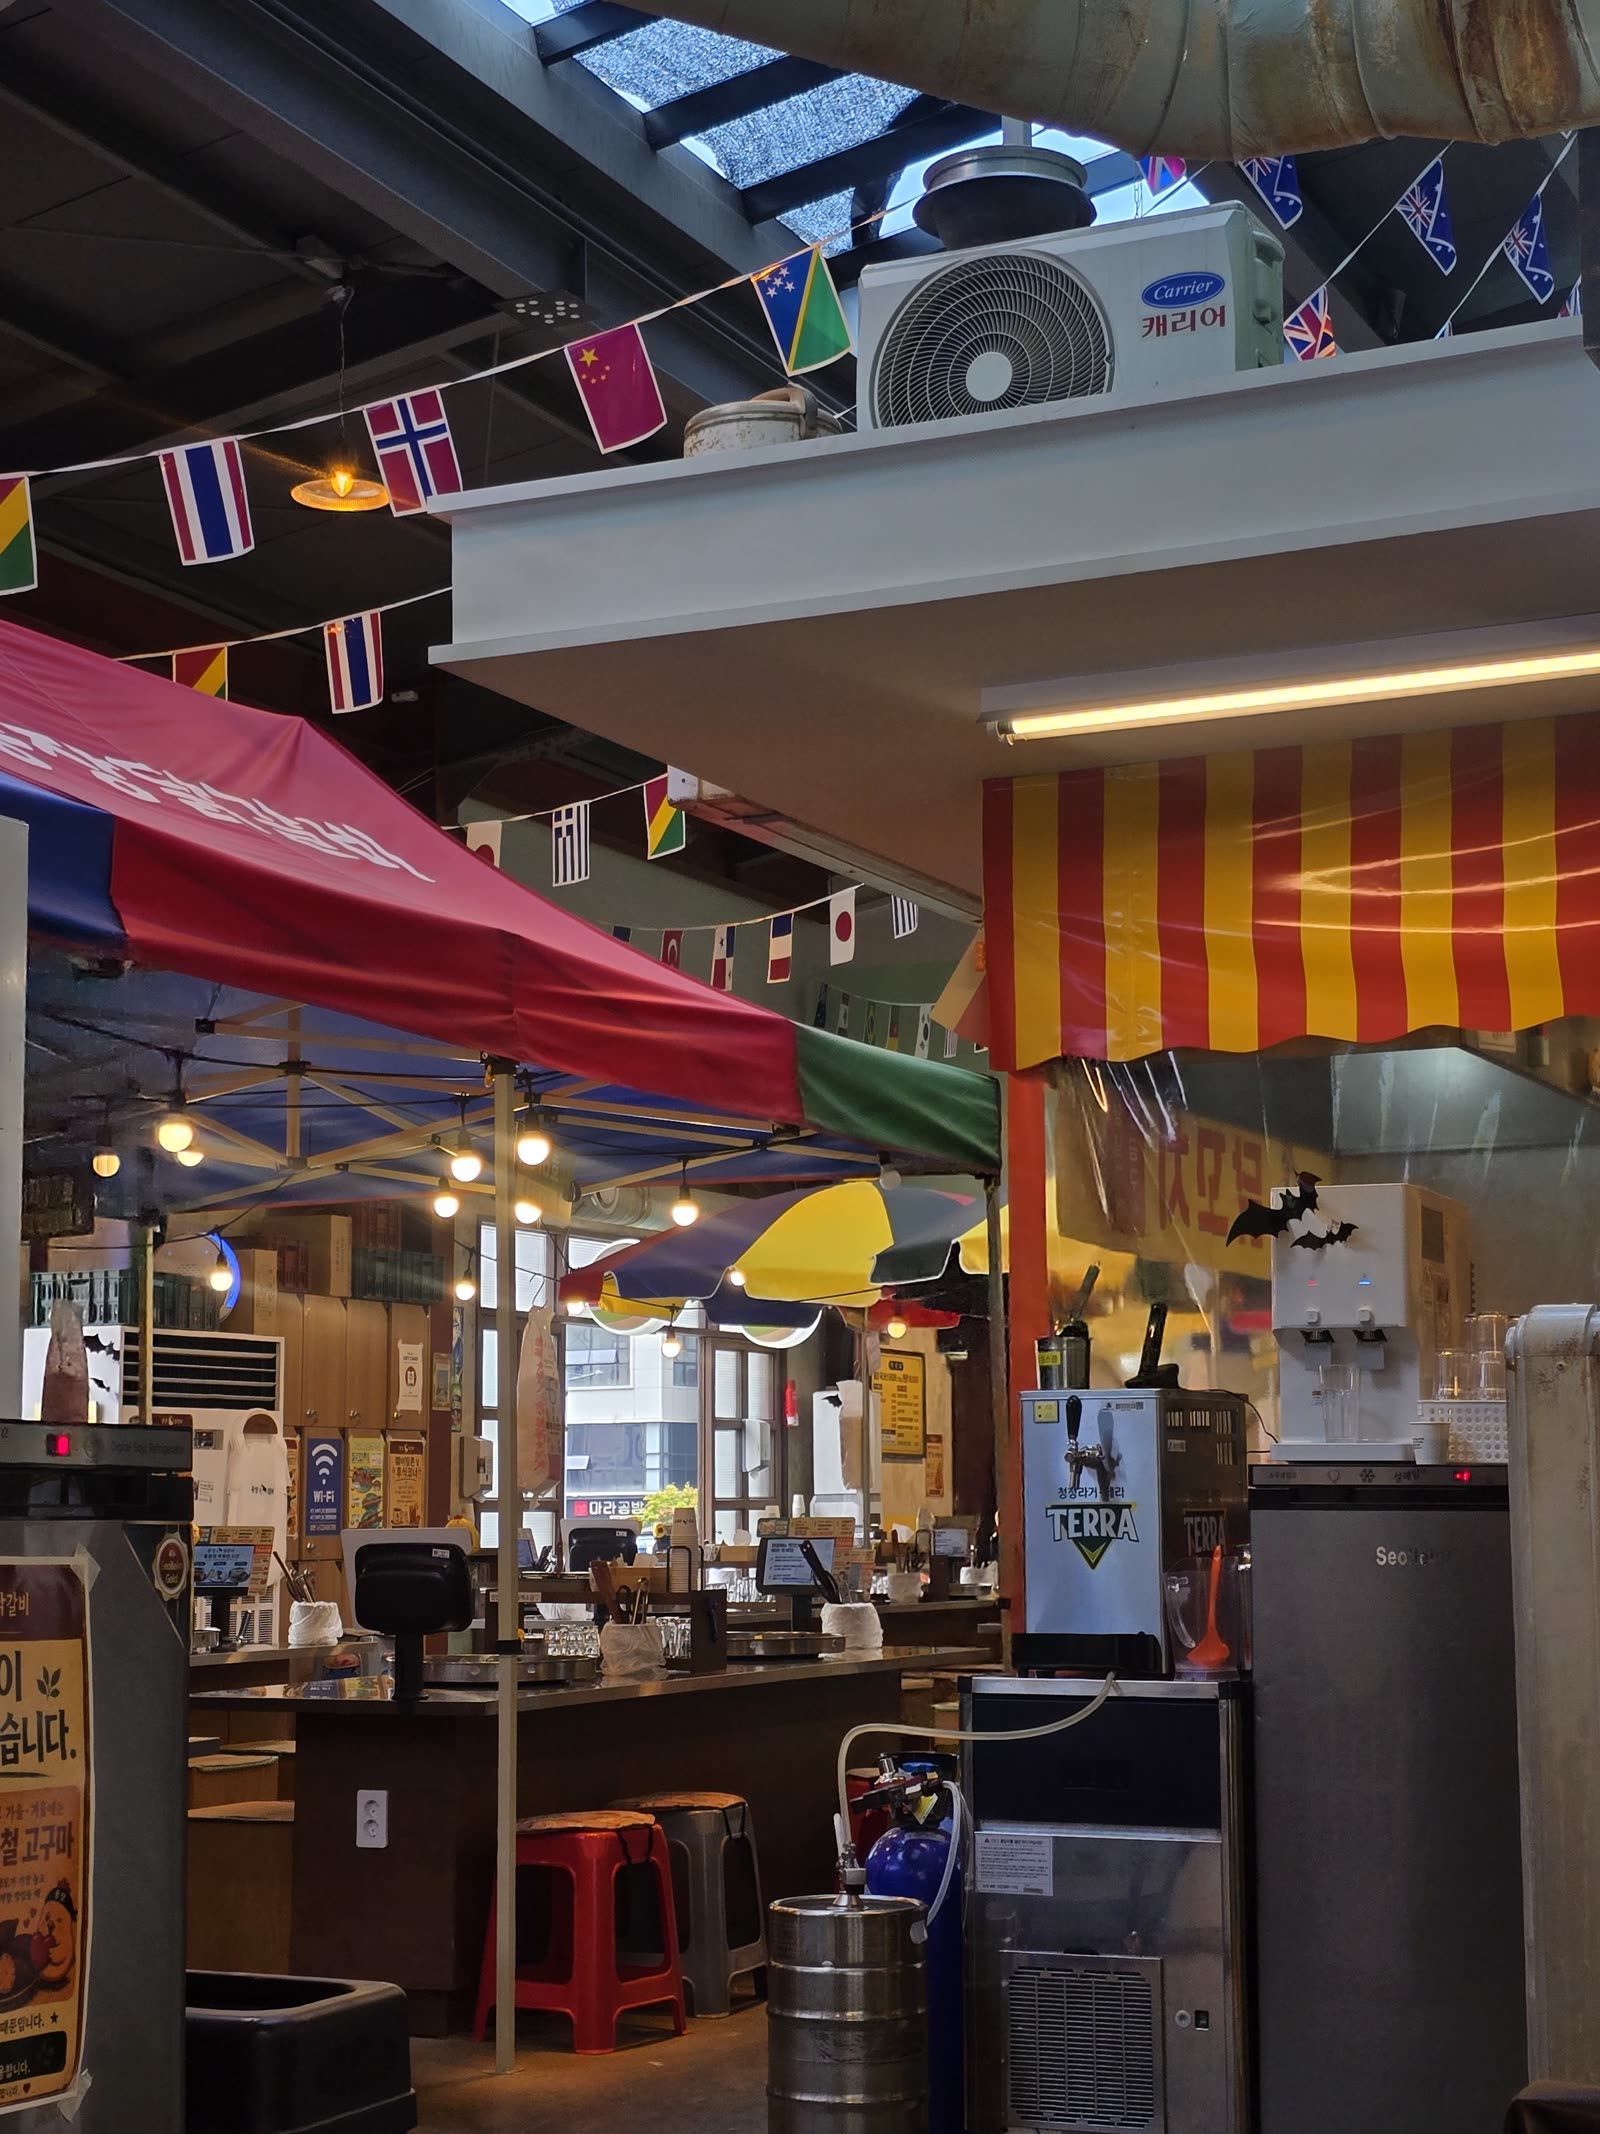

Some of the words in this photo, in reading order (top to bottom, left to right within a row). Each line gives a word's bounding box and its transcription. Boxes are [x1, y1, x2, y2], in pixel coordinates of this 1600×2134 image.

[1153, 277, 1214, 301] Carrier
[1142, 304, 1227, 338] 캐리어
[1046, 1507, 1139, 1542] TERRA
[1183, 1515, 1227, 1556] TERRA
[166, 1573, 179, 1584] Gold
[0, 1710, 77, 1765] 습니다.
[21, 1820, 75, 1864] 고구마
